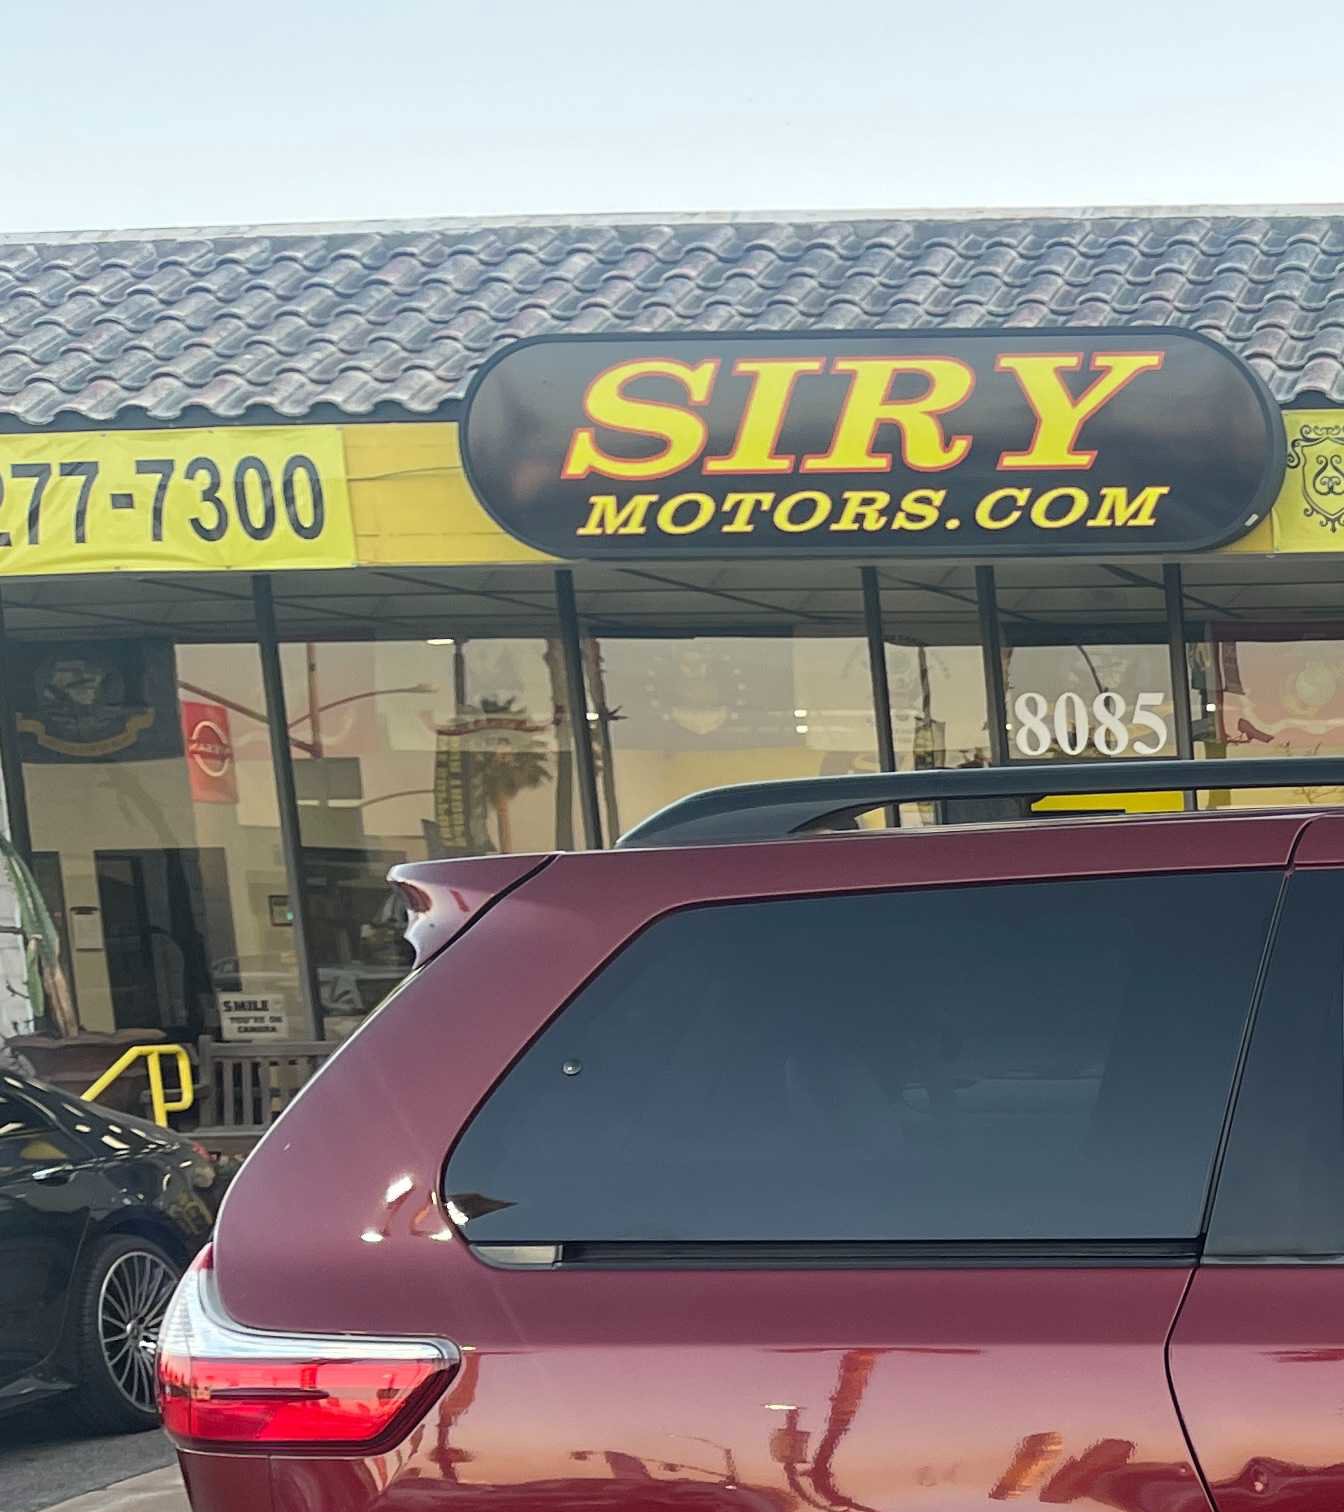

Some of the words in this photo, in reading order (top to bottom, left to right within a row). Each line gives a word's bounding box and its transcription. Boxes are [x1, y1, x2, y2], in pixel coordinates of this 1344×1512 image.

[561, 350, 1165, 481] SIRY
[576, 485, 1169, 538] MOTORS.COM
[1014, 691, 1168, 756] 8085
